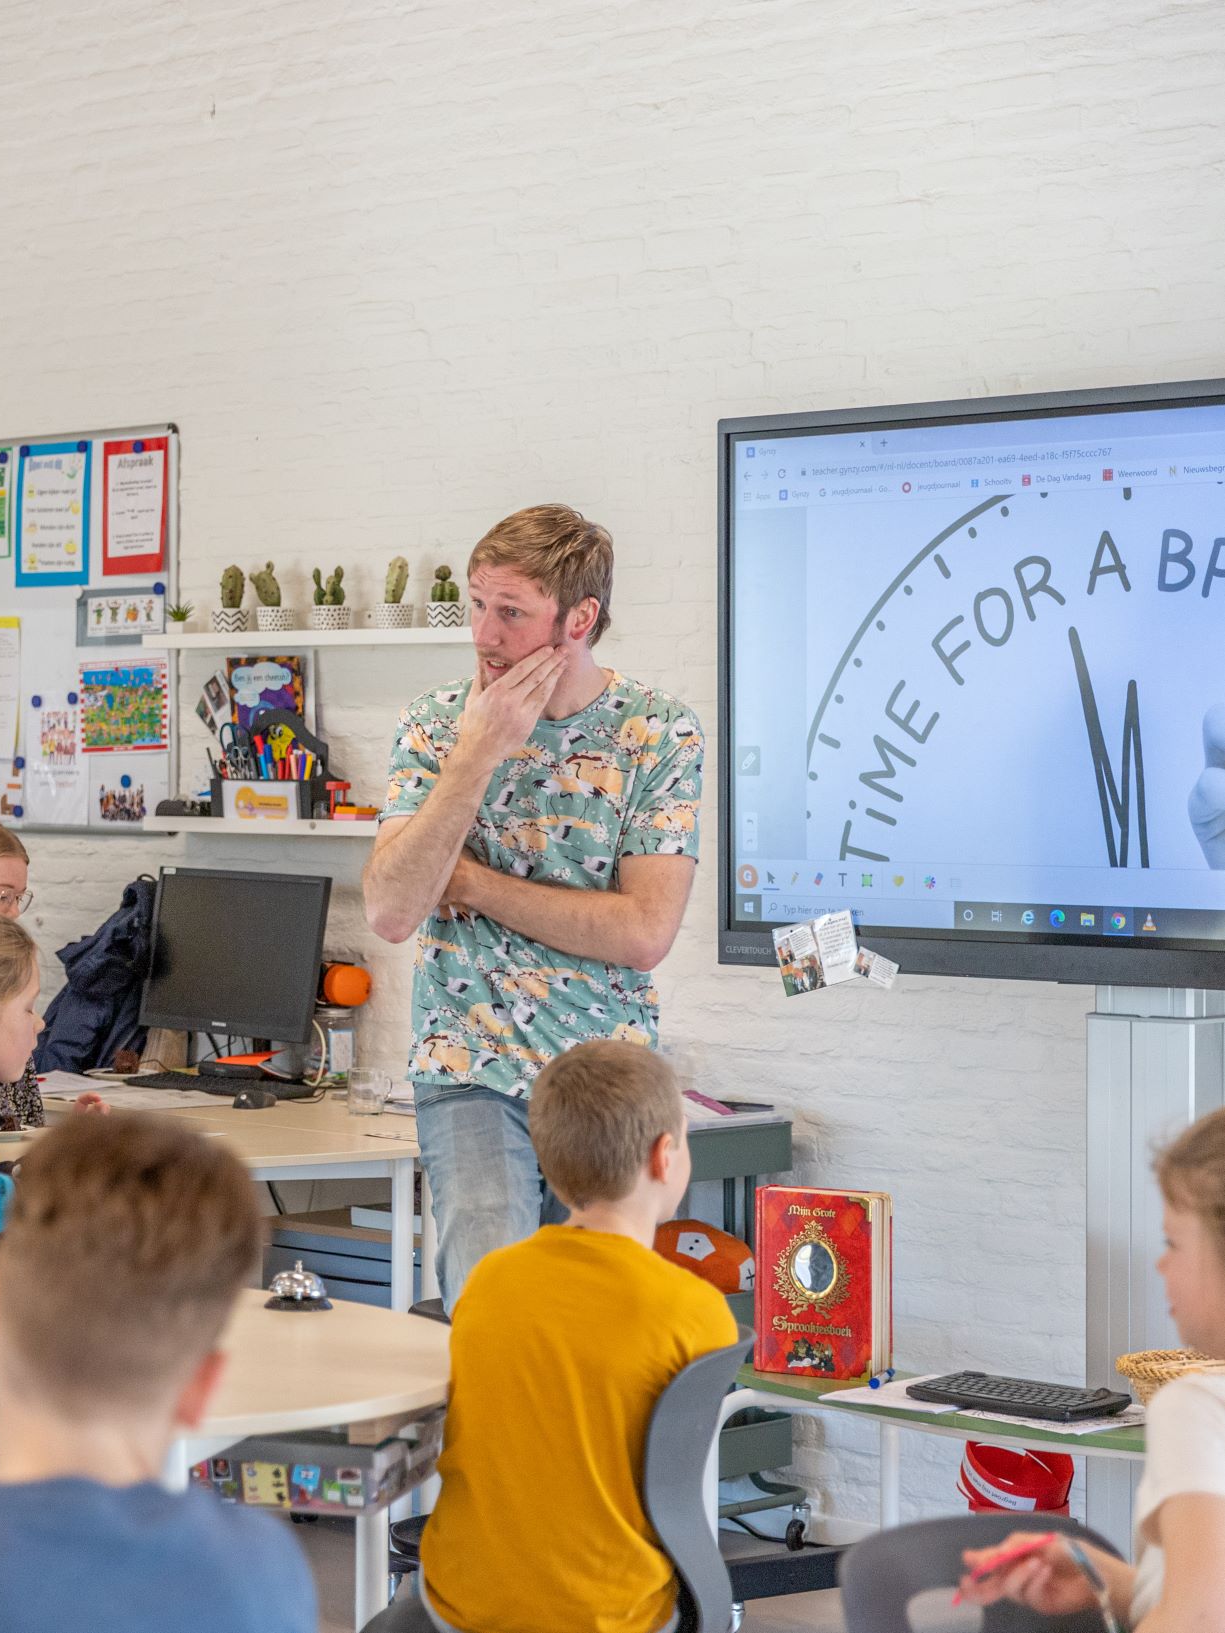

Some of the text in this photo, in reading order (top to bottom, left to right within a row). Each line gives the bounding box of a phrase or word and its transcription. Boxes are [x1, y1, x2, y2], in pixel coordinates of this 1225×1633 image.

[758, 448, 777, 457] Gynzy
[117, 456, 154, 470] Afspraak
[1036, 473, 1091, 484] De Dag Vandaag
[1118, 468, 1158, 479] Weerwoord
[984, 477, 1013, 486] Schooltv
[792, 490, 809, 499] Gynzy
[932, 555, 1066, 686] FOR
[1087, 530, 1132, 596] A
[784, 904, 798, 916] Typ
[798, 905, 812, 915] hier
[787, 1204, 836, 1218] Mijn Grote
[771, 1315, 852, 1337] Sprookjesboek
[991, 1491, 1017, 1506] Begroet
